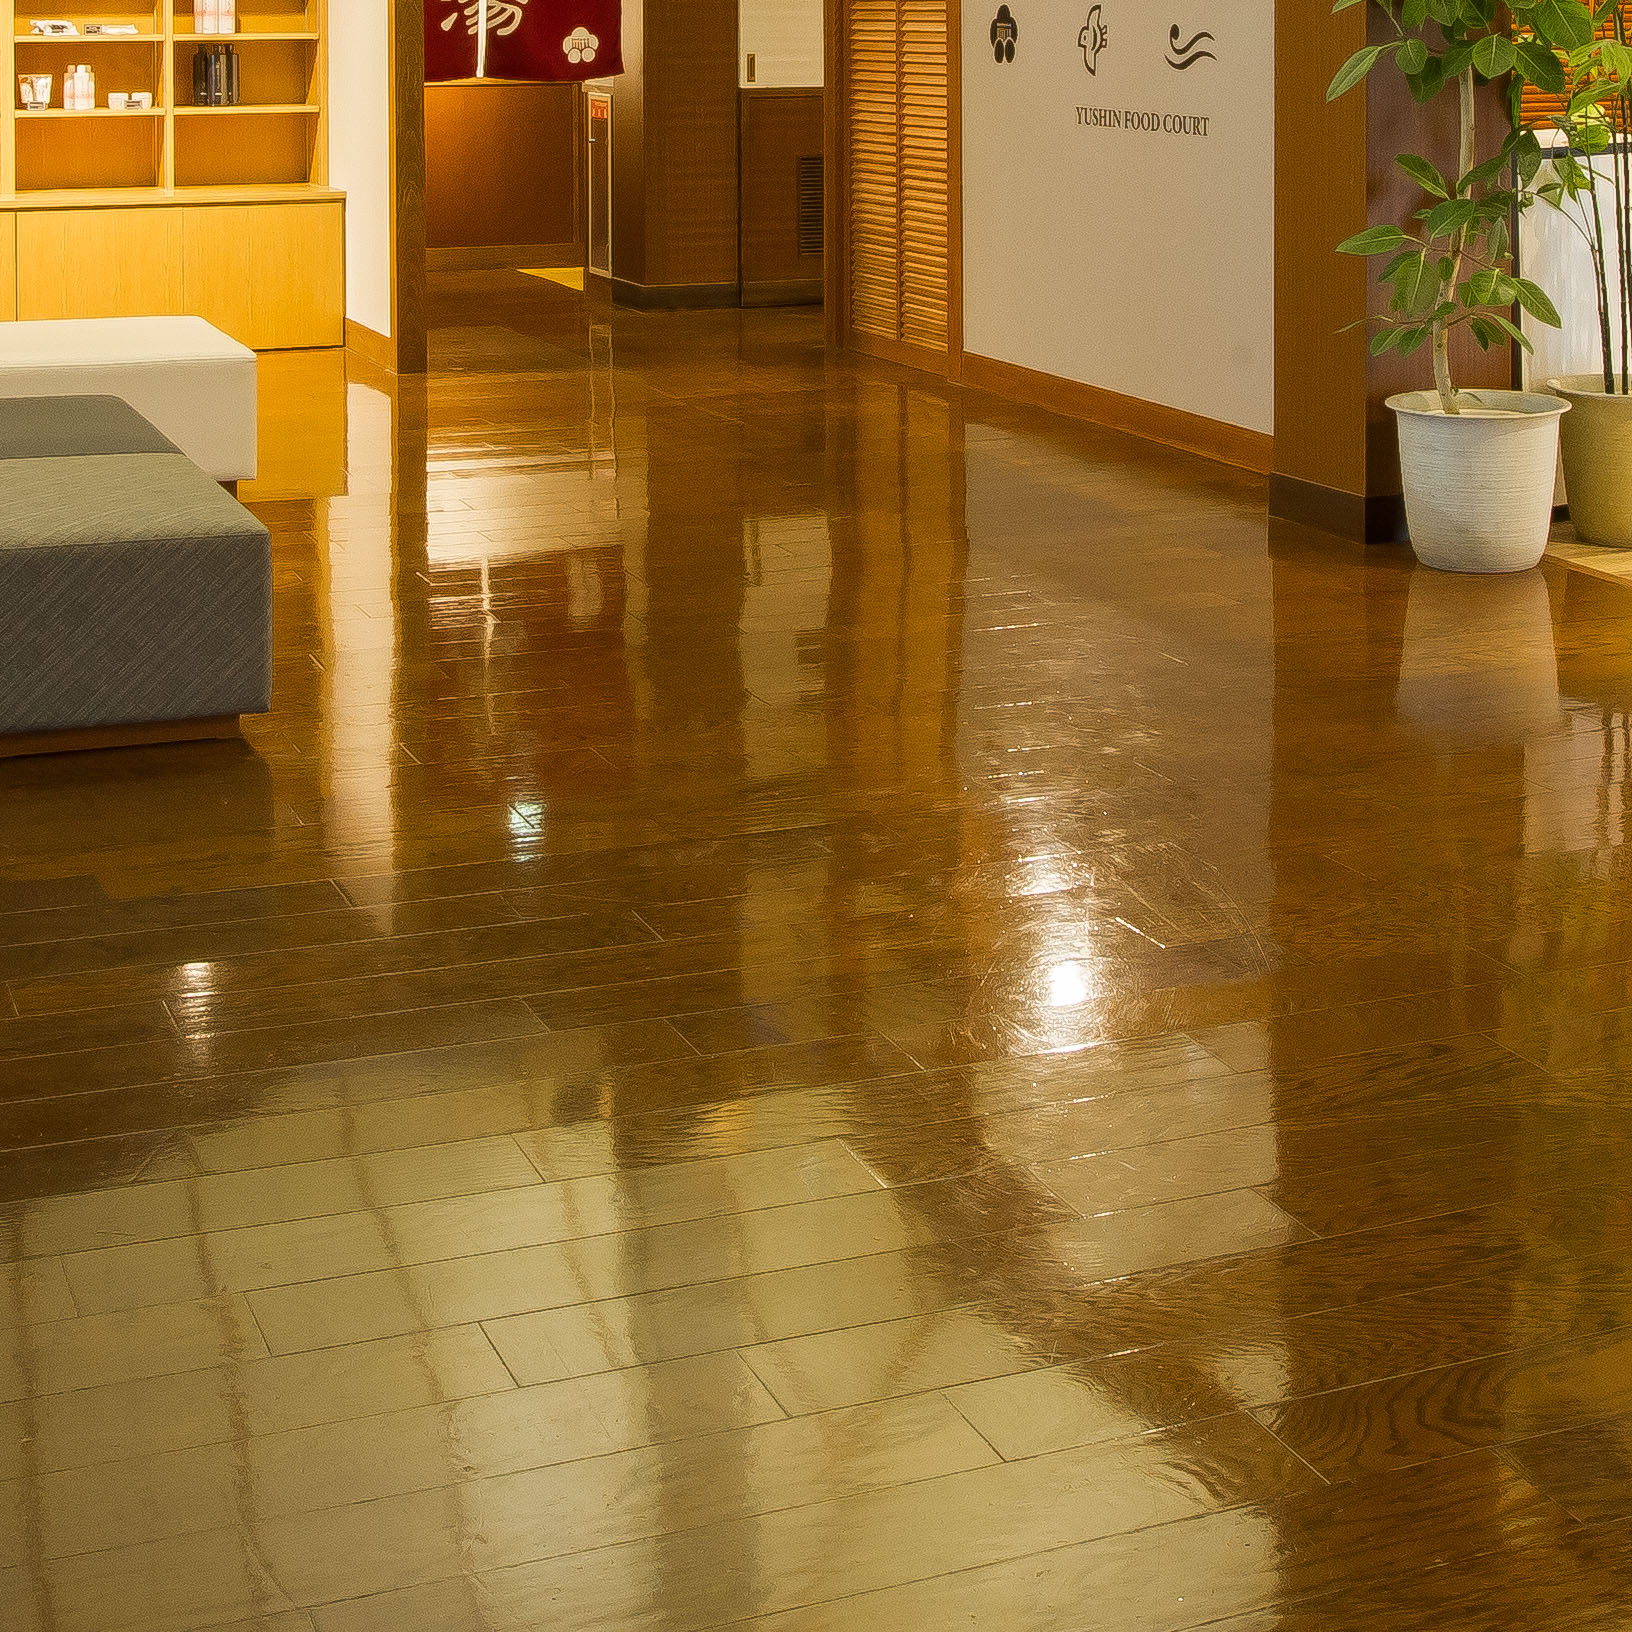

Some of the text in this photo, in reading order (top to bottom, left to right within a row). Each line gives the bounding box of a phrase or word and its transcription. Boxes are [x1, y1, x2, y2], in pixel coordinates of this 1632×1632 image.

[1075, 106, 1210, 137] YUSHIN FOOD COURT
